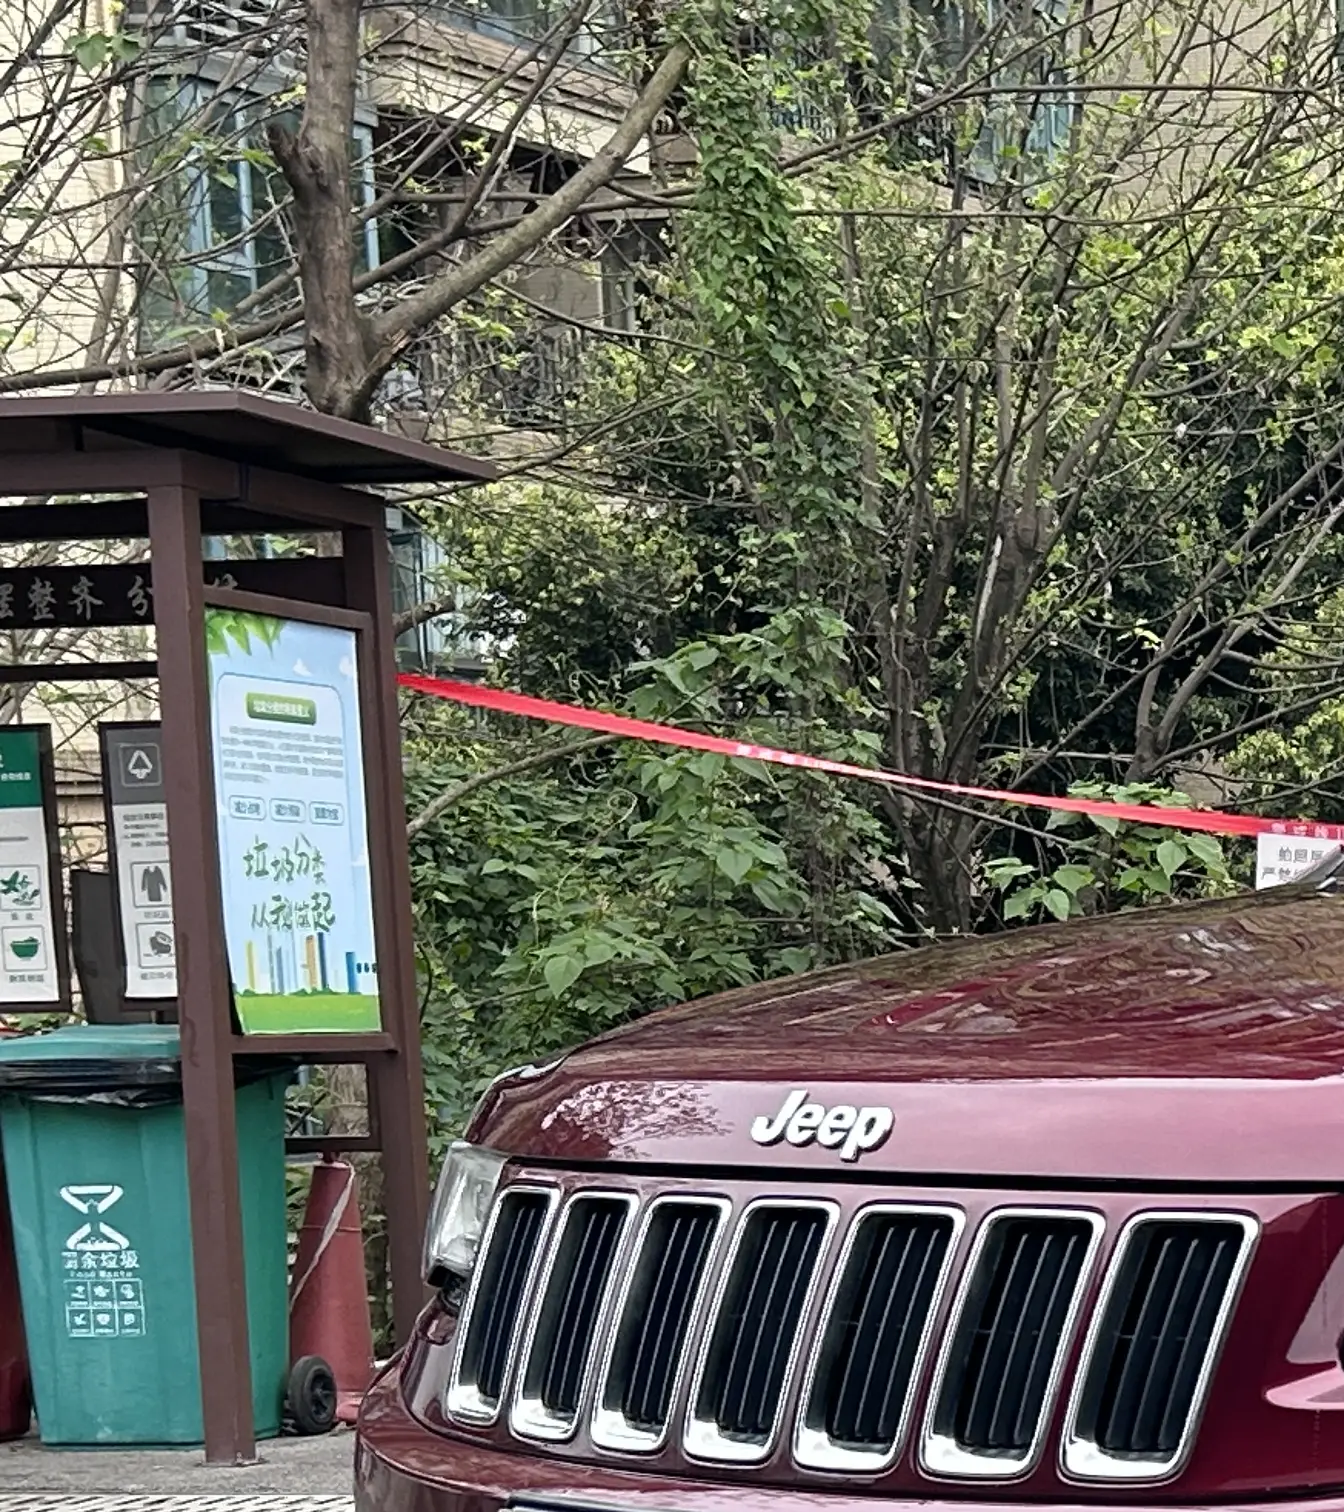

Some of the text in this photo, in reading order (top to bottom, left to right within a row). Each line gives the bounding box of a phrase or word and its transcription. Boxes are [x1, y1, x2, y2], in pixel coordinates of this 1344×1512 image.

[243, 832, 326, 885] 垃圾分类
[751, 1089, 896, 1163] Jeep
